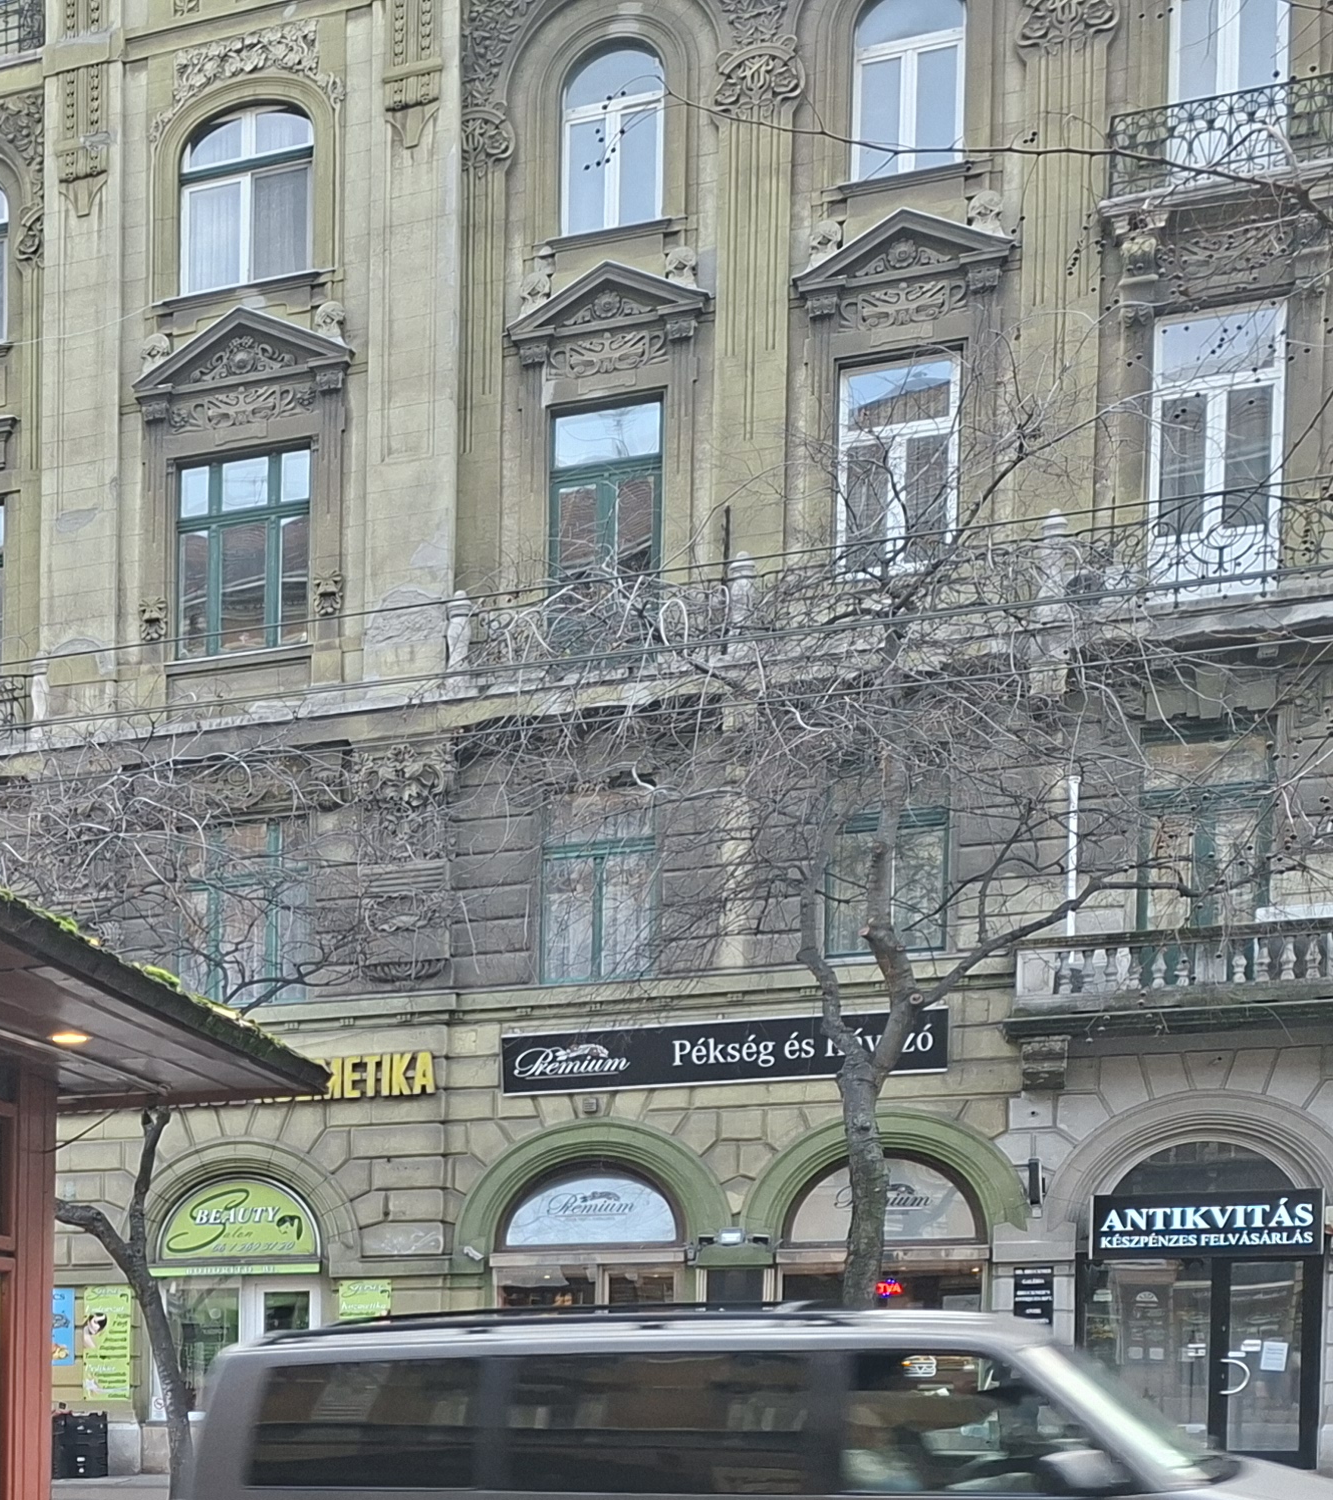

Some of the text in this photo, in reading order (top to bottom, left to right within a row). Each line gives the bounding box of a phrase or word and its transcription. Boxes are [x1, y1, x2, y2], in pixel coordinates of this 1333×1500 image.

[513, 1046, 630, 1078] Premium
[672, 1033, 776, 1069] Pékség
[784, 1032, 815, 1060] és
[319, 1051, 437, 1100] METIKA
[546, 1192, 634, 1216] Premium
[834, 1184, 932, 1209] Pium
[195, 1206, 280, 1225] BEAUTY
[1100, 1198, 1314, 1231] ANTIKVITÁS
[1100, 1229, 1314, 1248] KÉSZPÉNZES FELVÁSÁRLÁS
